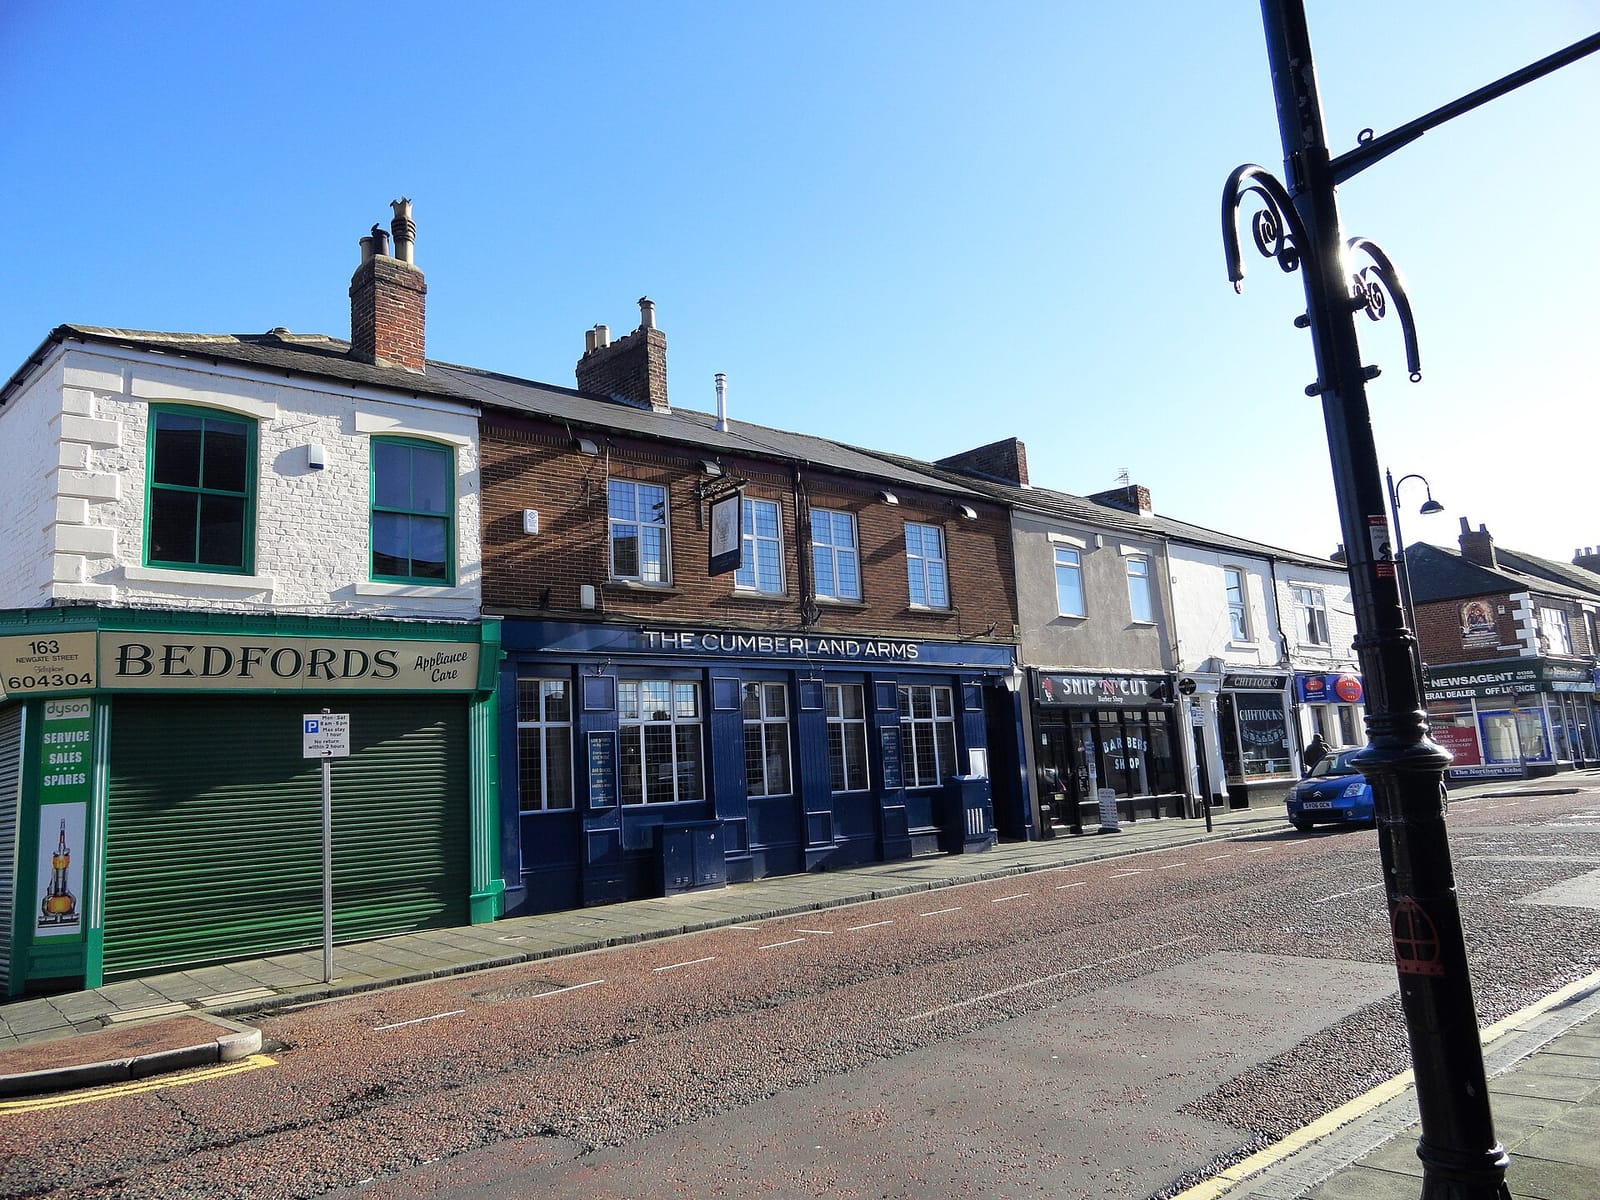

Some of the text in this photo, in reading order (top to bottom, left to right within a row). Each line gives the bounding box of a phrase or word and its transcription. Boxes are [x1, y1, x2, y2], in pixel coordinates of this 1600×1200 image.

[28, 640, 60, 655] 163
[643, 631, 919, 659] THE CUMBERLAND ARMS
[15, 654, 79, 664] NEWGATE STREET
[114, 643, 400, 681] BEDFORDS
[413, 651, 469, 672] Appliance
[8, 672, 93, 690] 604304
[431, 668, 459, 683] Care
[1234, 677, 1279, 688] CHITTOCK'S
[1431, 671, 1514, 688] NEWSAGENT
[1063, 678, 1097, 696] SNIP
[1120, 678, 1149, 696] CUT
[1446, 689, 1477, 699] DEALER
[1485, 686, 1500, 696] OFF
[46, 702, 90, 718] dyson
[1239, 709, 1285, 721] CHITTOCK'S
[308, 721, 318, 733] P
[43, 730, 90, 744] SERVICE
[49, 751, 83, 765] SALES
[1469, 768, 1503, 776] Northern
[43, 773, 86, 787] SPARES
